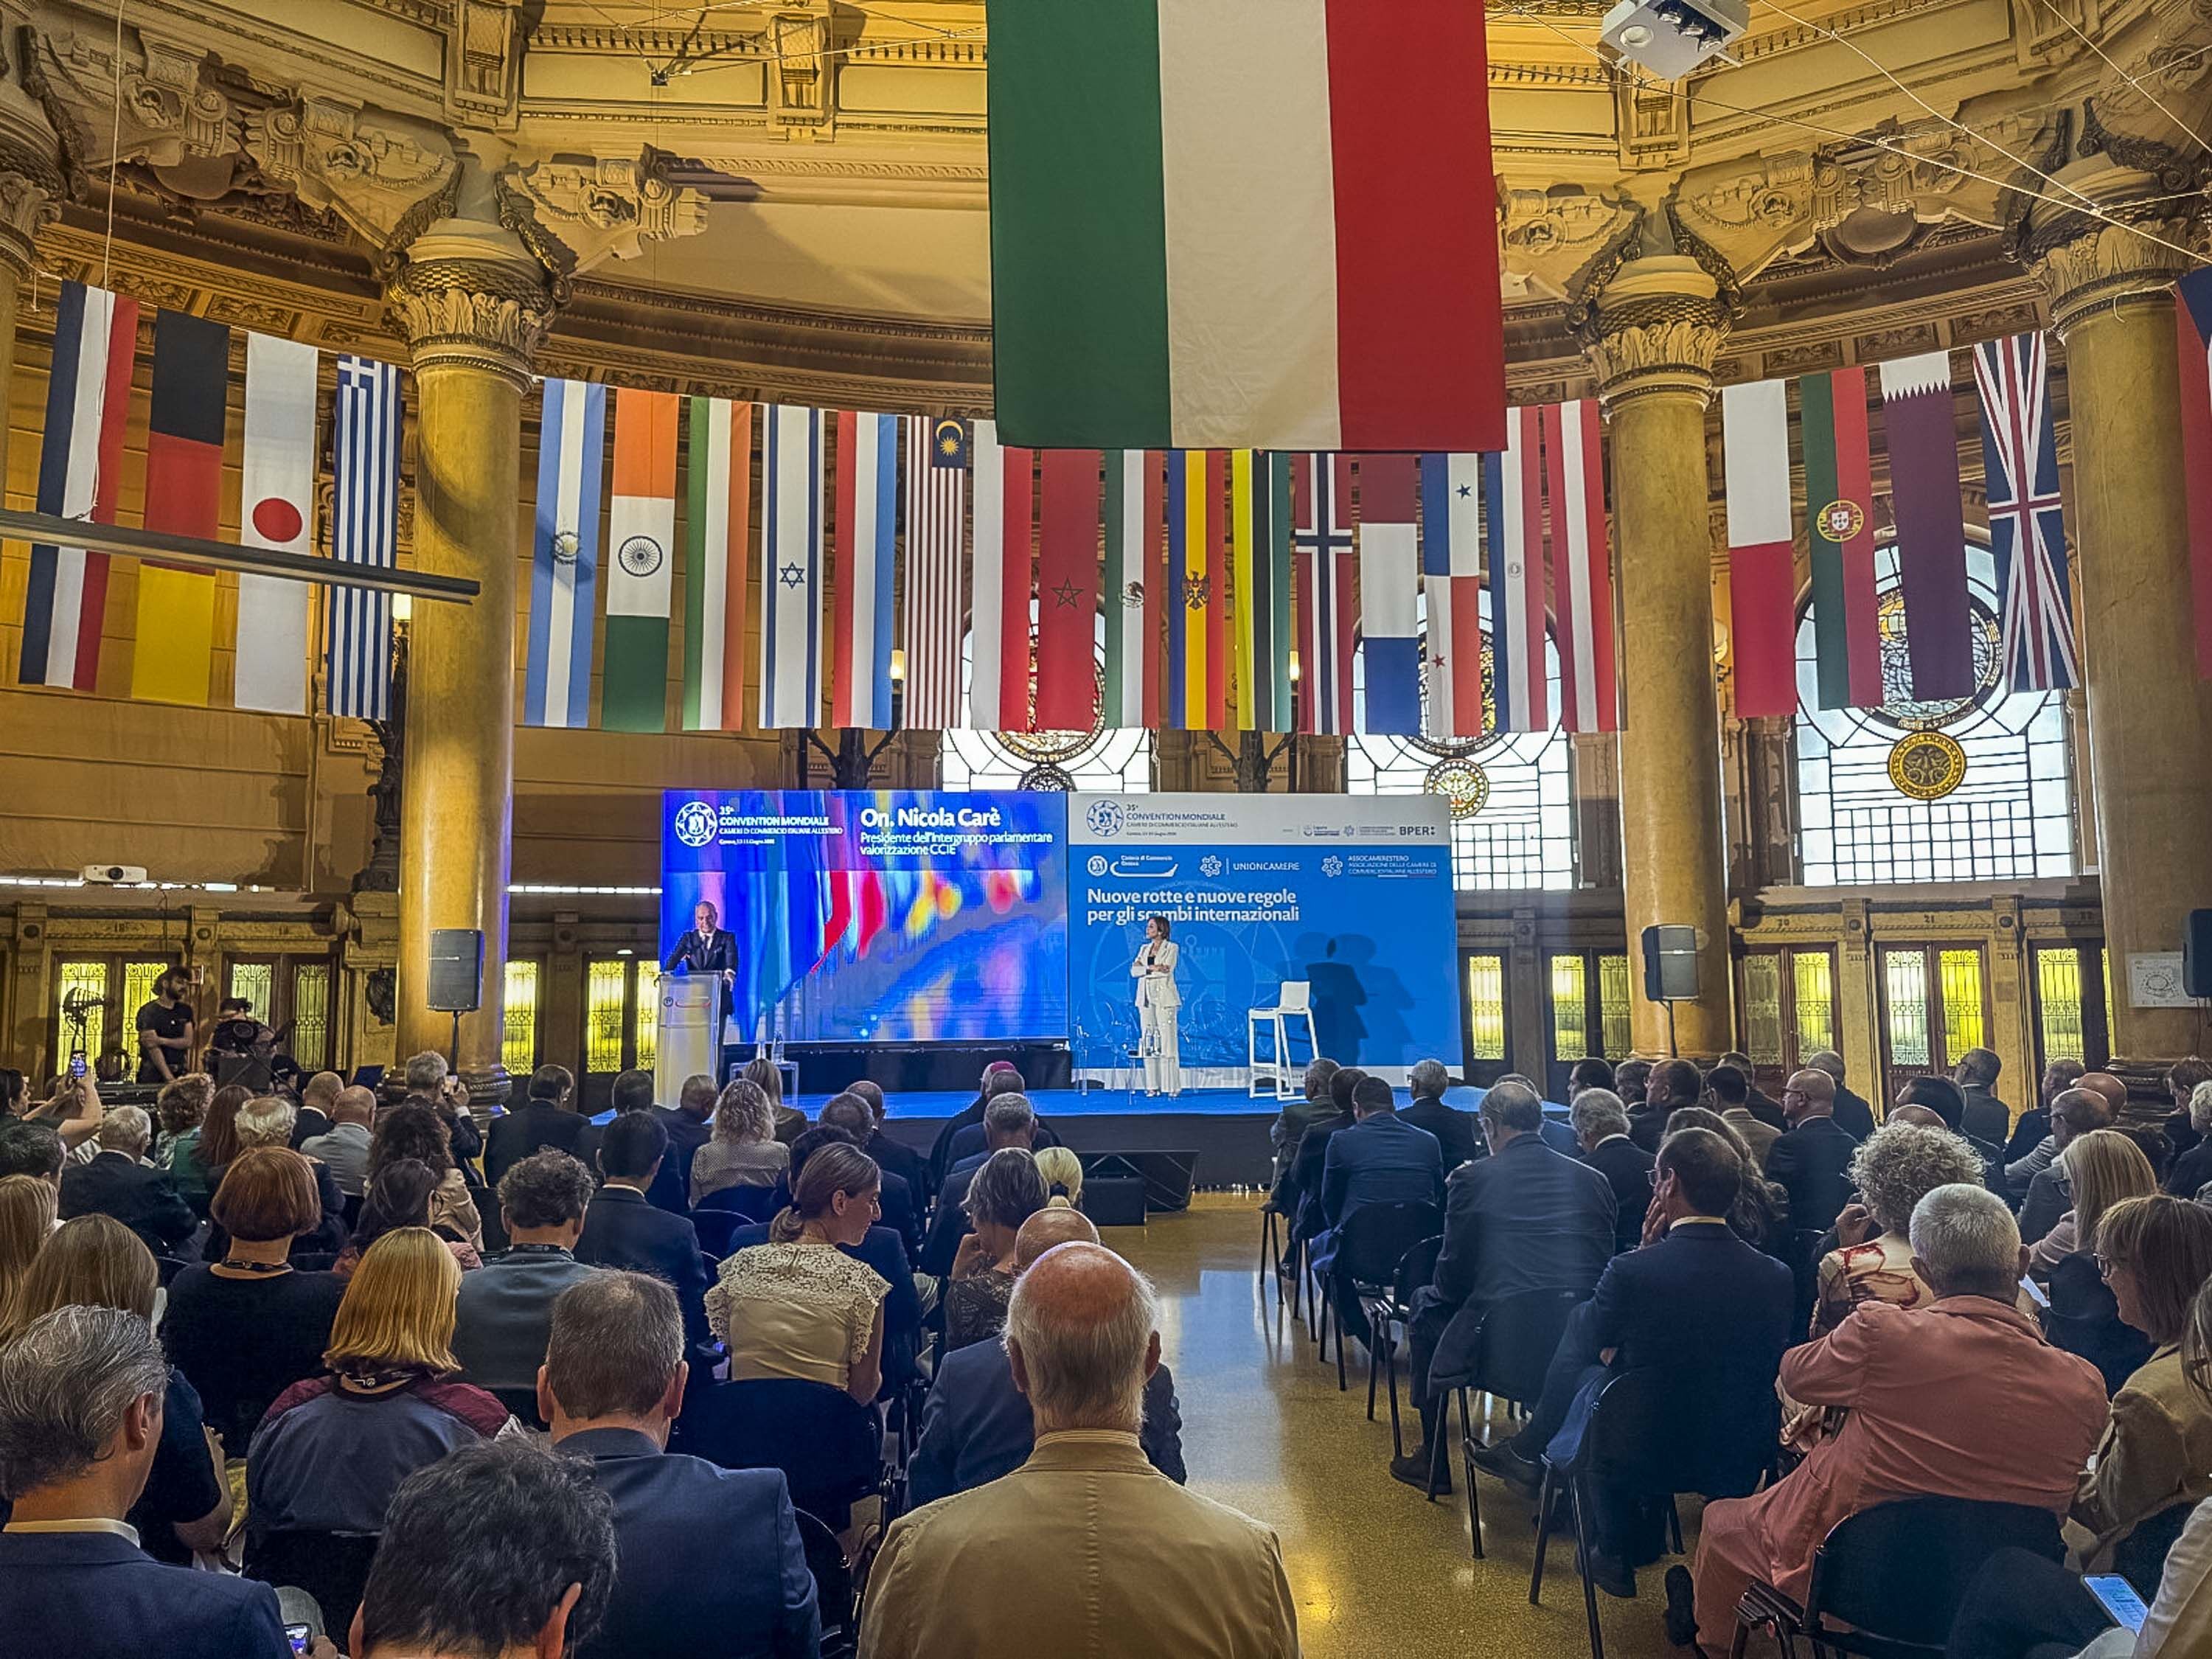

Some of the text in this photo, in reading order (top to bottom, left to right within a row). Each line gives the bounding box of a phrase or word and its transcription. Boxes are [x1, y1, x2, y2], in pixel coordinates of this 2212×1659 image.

[719, 816, 830, 827] CONVENTION MONDIALE
[860, 807, 1001, 827] On. Nicola Carè
[1126, 813, 1226, 821] CONVENTION MONDIALE
[860, 831, 911, 843] Presidente
[989, 831, 1053, 845] parlamentare
[860, 844, 956, 855] valorizzazione CCIE
[1233, 862, 1300, 871] UNIONCAMERE
[1088, 888, 1296, 908] Nuove rotte e nuove regole
[1088, 909, 1115, 925] per
[1116, 905, 1135, 925] gli
[1194, 906, 1300, 921] internazionali
[1923, 914, 1935, 923] 21
